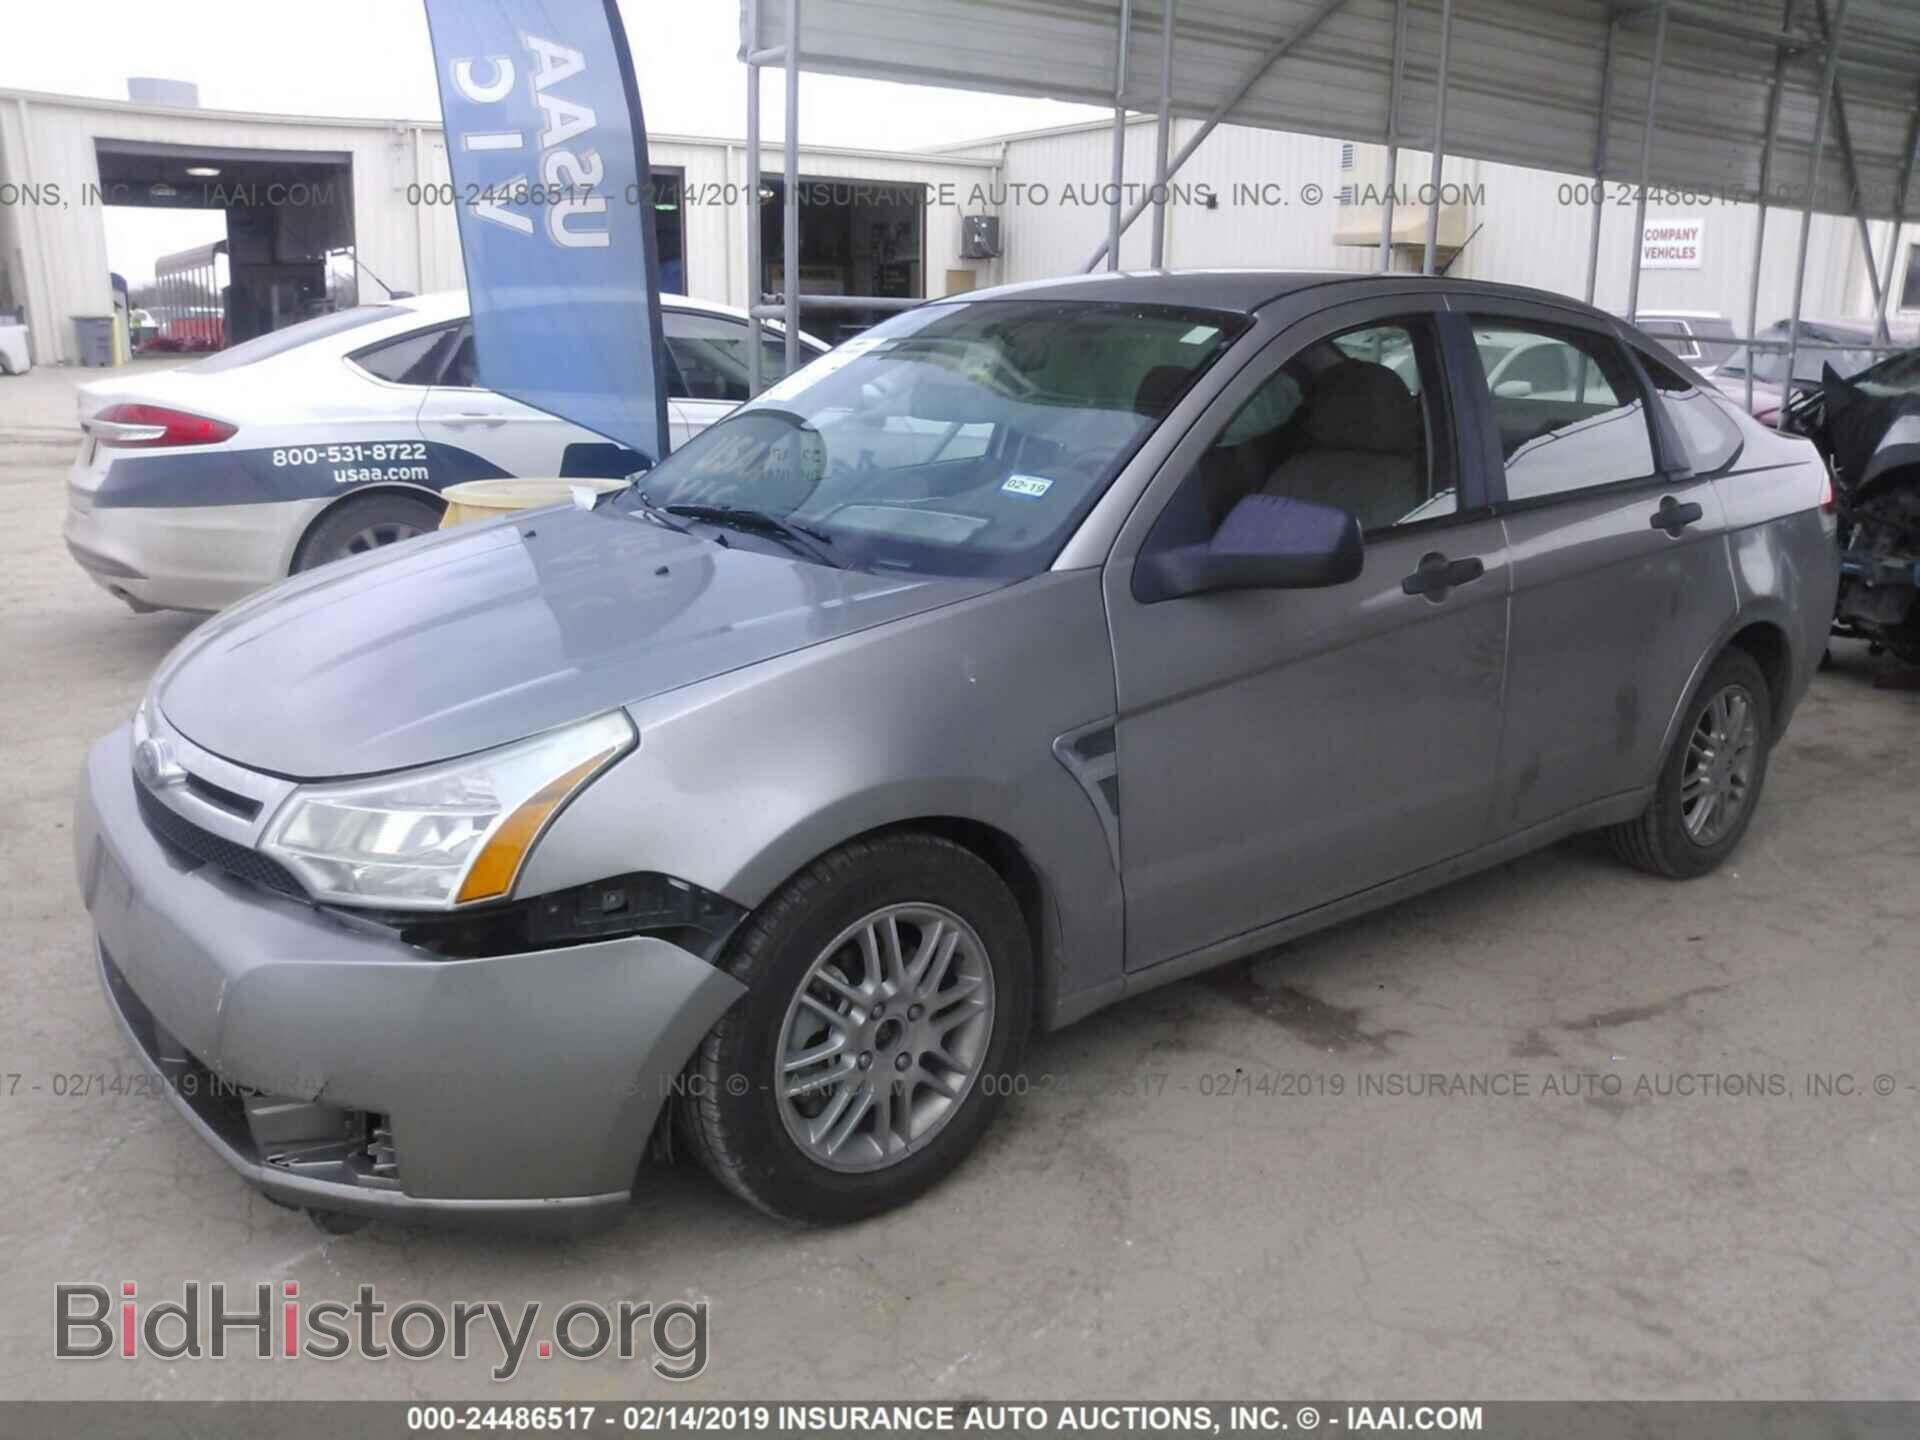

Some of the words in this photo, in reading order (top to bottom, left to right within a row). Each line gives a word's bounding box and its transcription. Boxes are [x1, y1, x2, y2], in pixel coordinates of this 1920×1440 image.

[1644, 227, 1699, 241] COMPANY
[1643, 246, 1697, 260] VEHICLES
[272, 443, 428, 467] 800-531-8722
[333, 466, 429, 483] usaa.com
